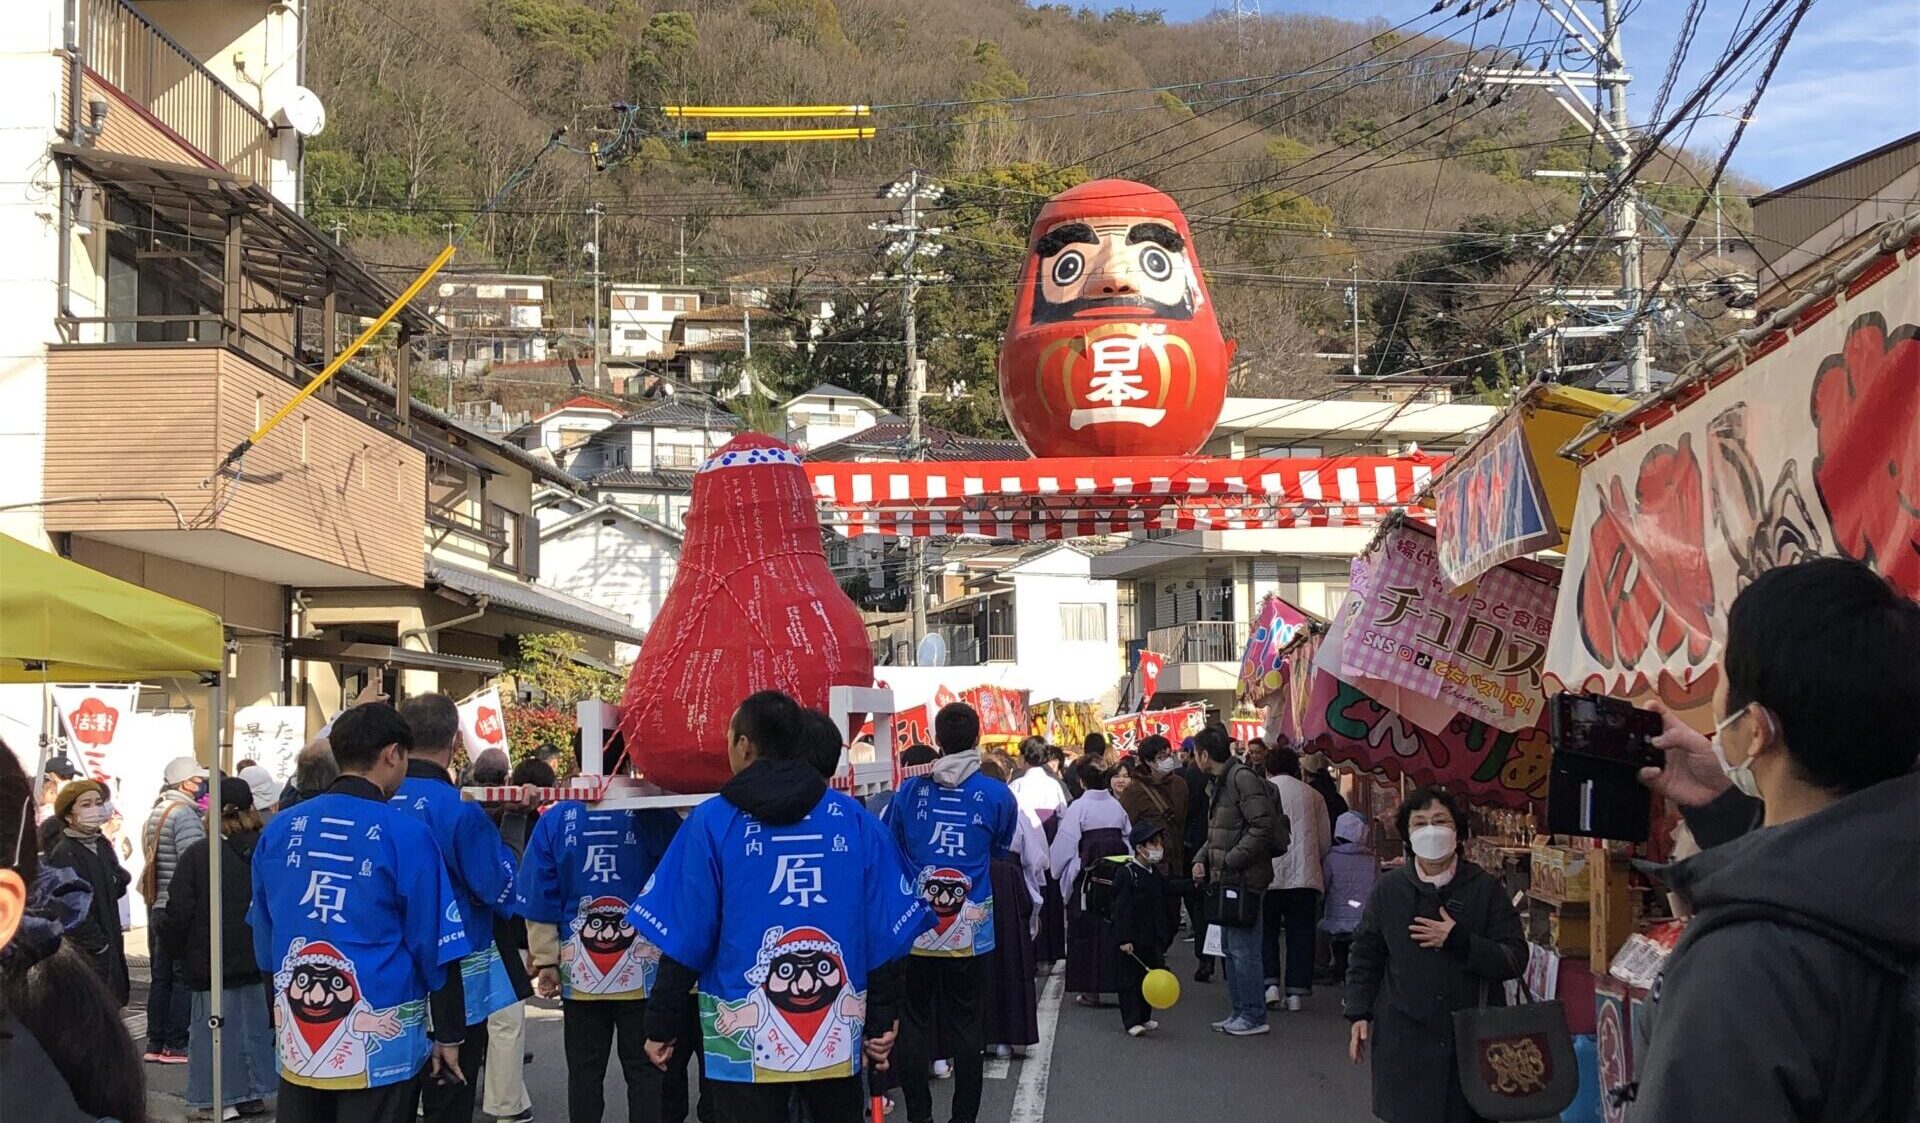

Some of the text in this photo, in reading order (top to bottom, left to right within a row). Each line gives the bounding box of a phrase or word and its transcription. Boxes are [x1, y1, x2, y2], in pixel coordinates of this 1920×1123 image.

[1070, 338, 1167, 430] 日本一
[1363, 631, 1396, 654] SNS
[1373, 585, 1548, 690] チュロス
[286, 815, 309, 868] 瀬戸内
[358, 823, 383, 878] 広島
[827, 801, 849, 852] 広島
[928, 787, 968, 857] 三原
[299, 817, 355, 924] 三原
